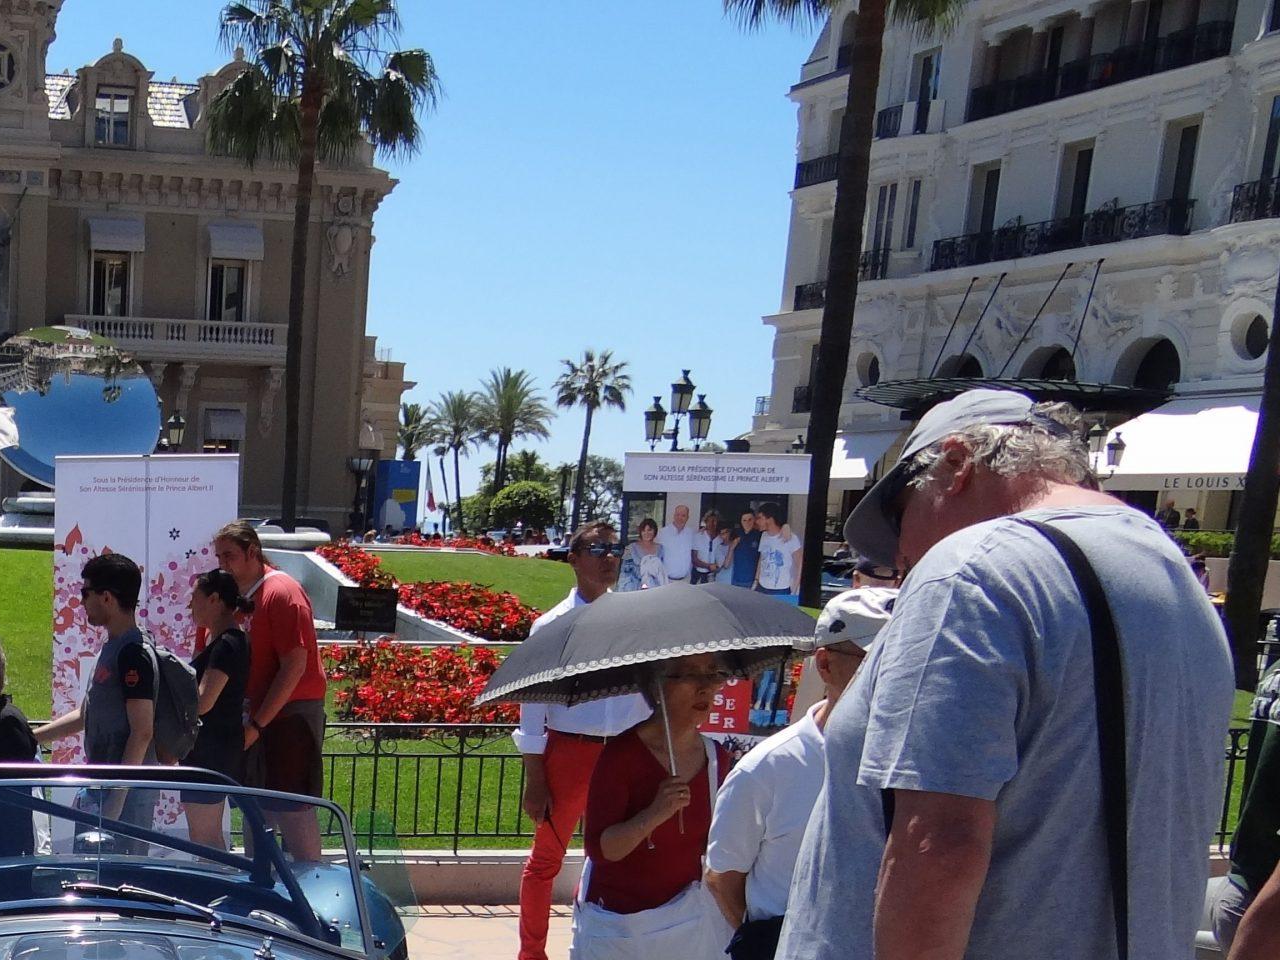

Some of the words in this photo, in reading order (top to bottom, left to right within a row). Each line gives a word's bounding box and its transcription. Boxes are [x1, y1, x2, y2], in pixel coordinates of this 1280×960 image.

[658, 465, 677, 473] SOUS
[677, 465, 686, 473] LA
[767, 466, 776, 474] DE
[92, 476, 109, 484] Sous
[109, 476, 116, 484] la
[117, 475, 153, 484] Présidence
[154, 475, 190, 484] d'Honneur
[191, 475, 200, 483] de
[643, 474, 659, 482] SON
[659, 474, 685, 482] ALTESSE
[736, 475, 760, 483] PRINCE
[760, 475, 784, 483] ALBERT
[1164, 477, 1180, 489] LE
[1186, 476, 1229, 488] LOUIS
[79, 485, 92, 493] Son
[93, 485, 117, 493] Altesse
[158, 485, 165, 493] le
[165, 485, 186, 493] Prince
[187, 485, 208, 493] Albert
